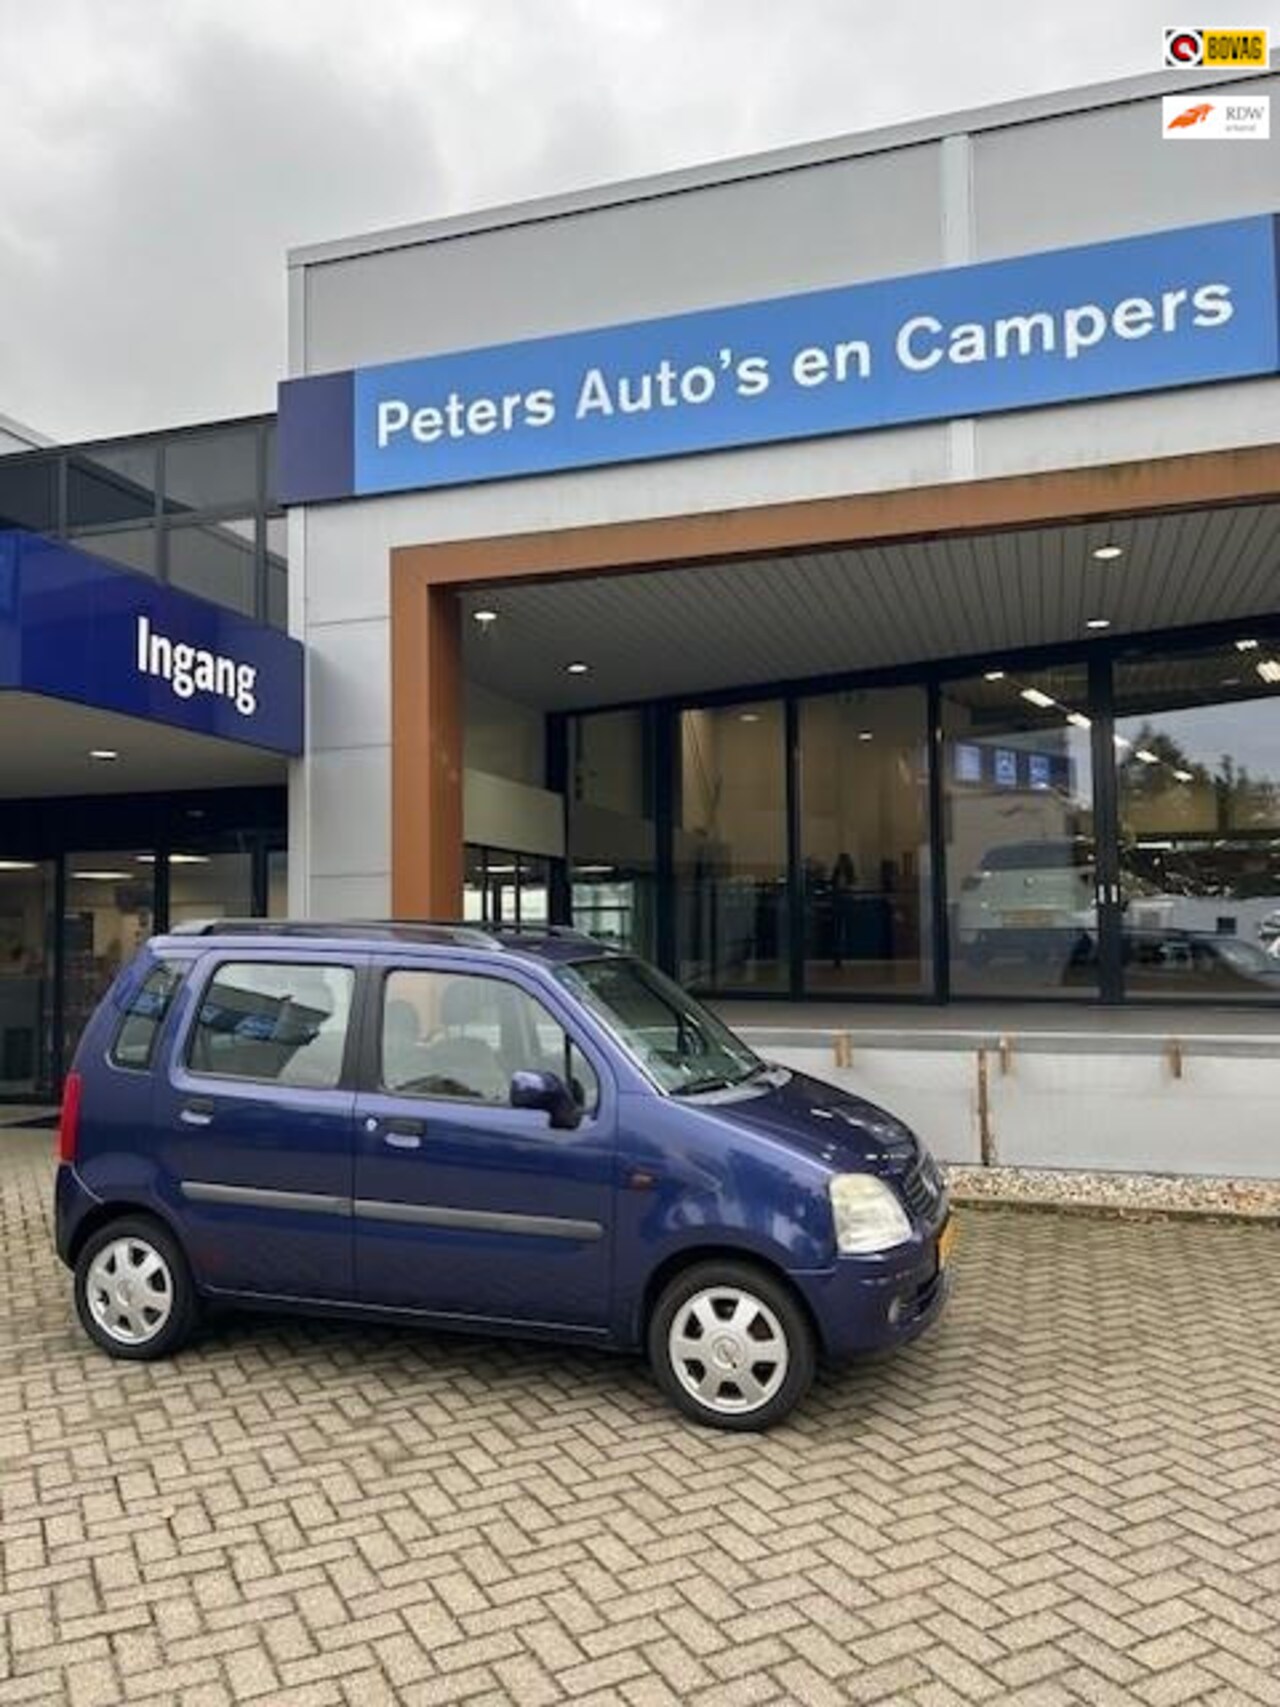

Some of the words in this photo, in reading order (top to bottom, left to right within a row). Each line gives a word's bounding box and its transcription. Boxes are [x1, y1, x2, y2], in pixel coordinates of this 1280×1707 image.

[376, 386, 556, 449] Peters
[575, 347, 770, 420] Auto's
[792, 340, 872, 388] en
[895, 282, 1235, 372] Campers
[137, 615, 257, 715] Ingang
